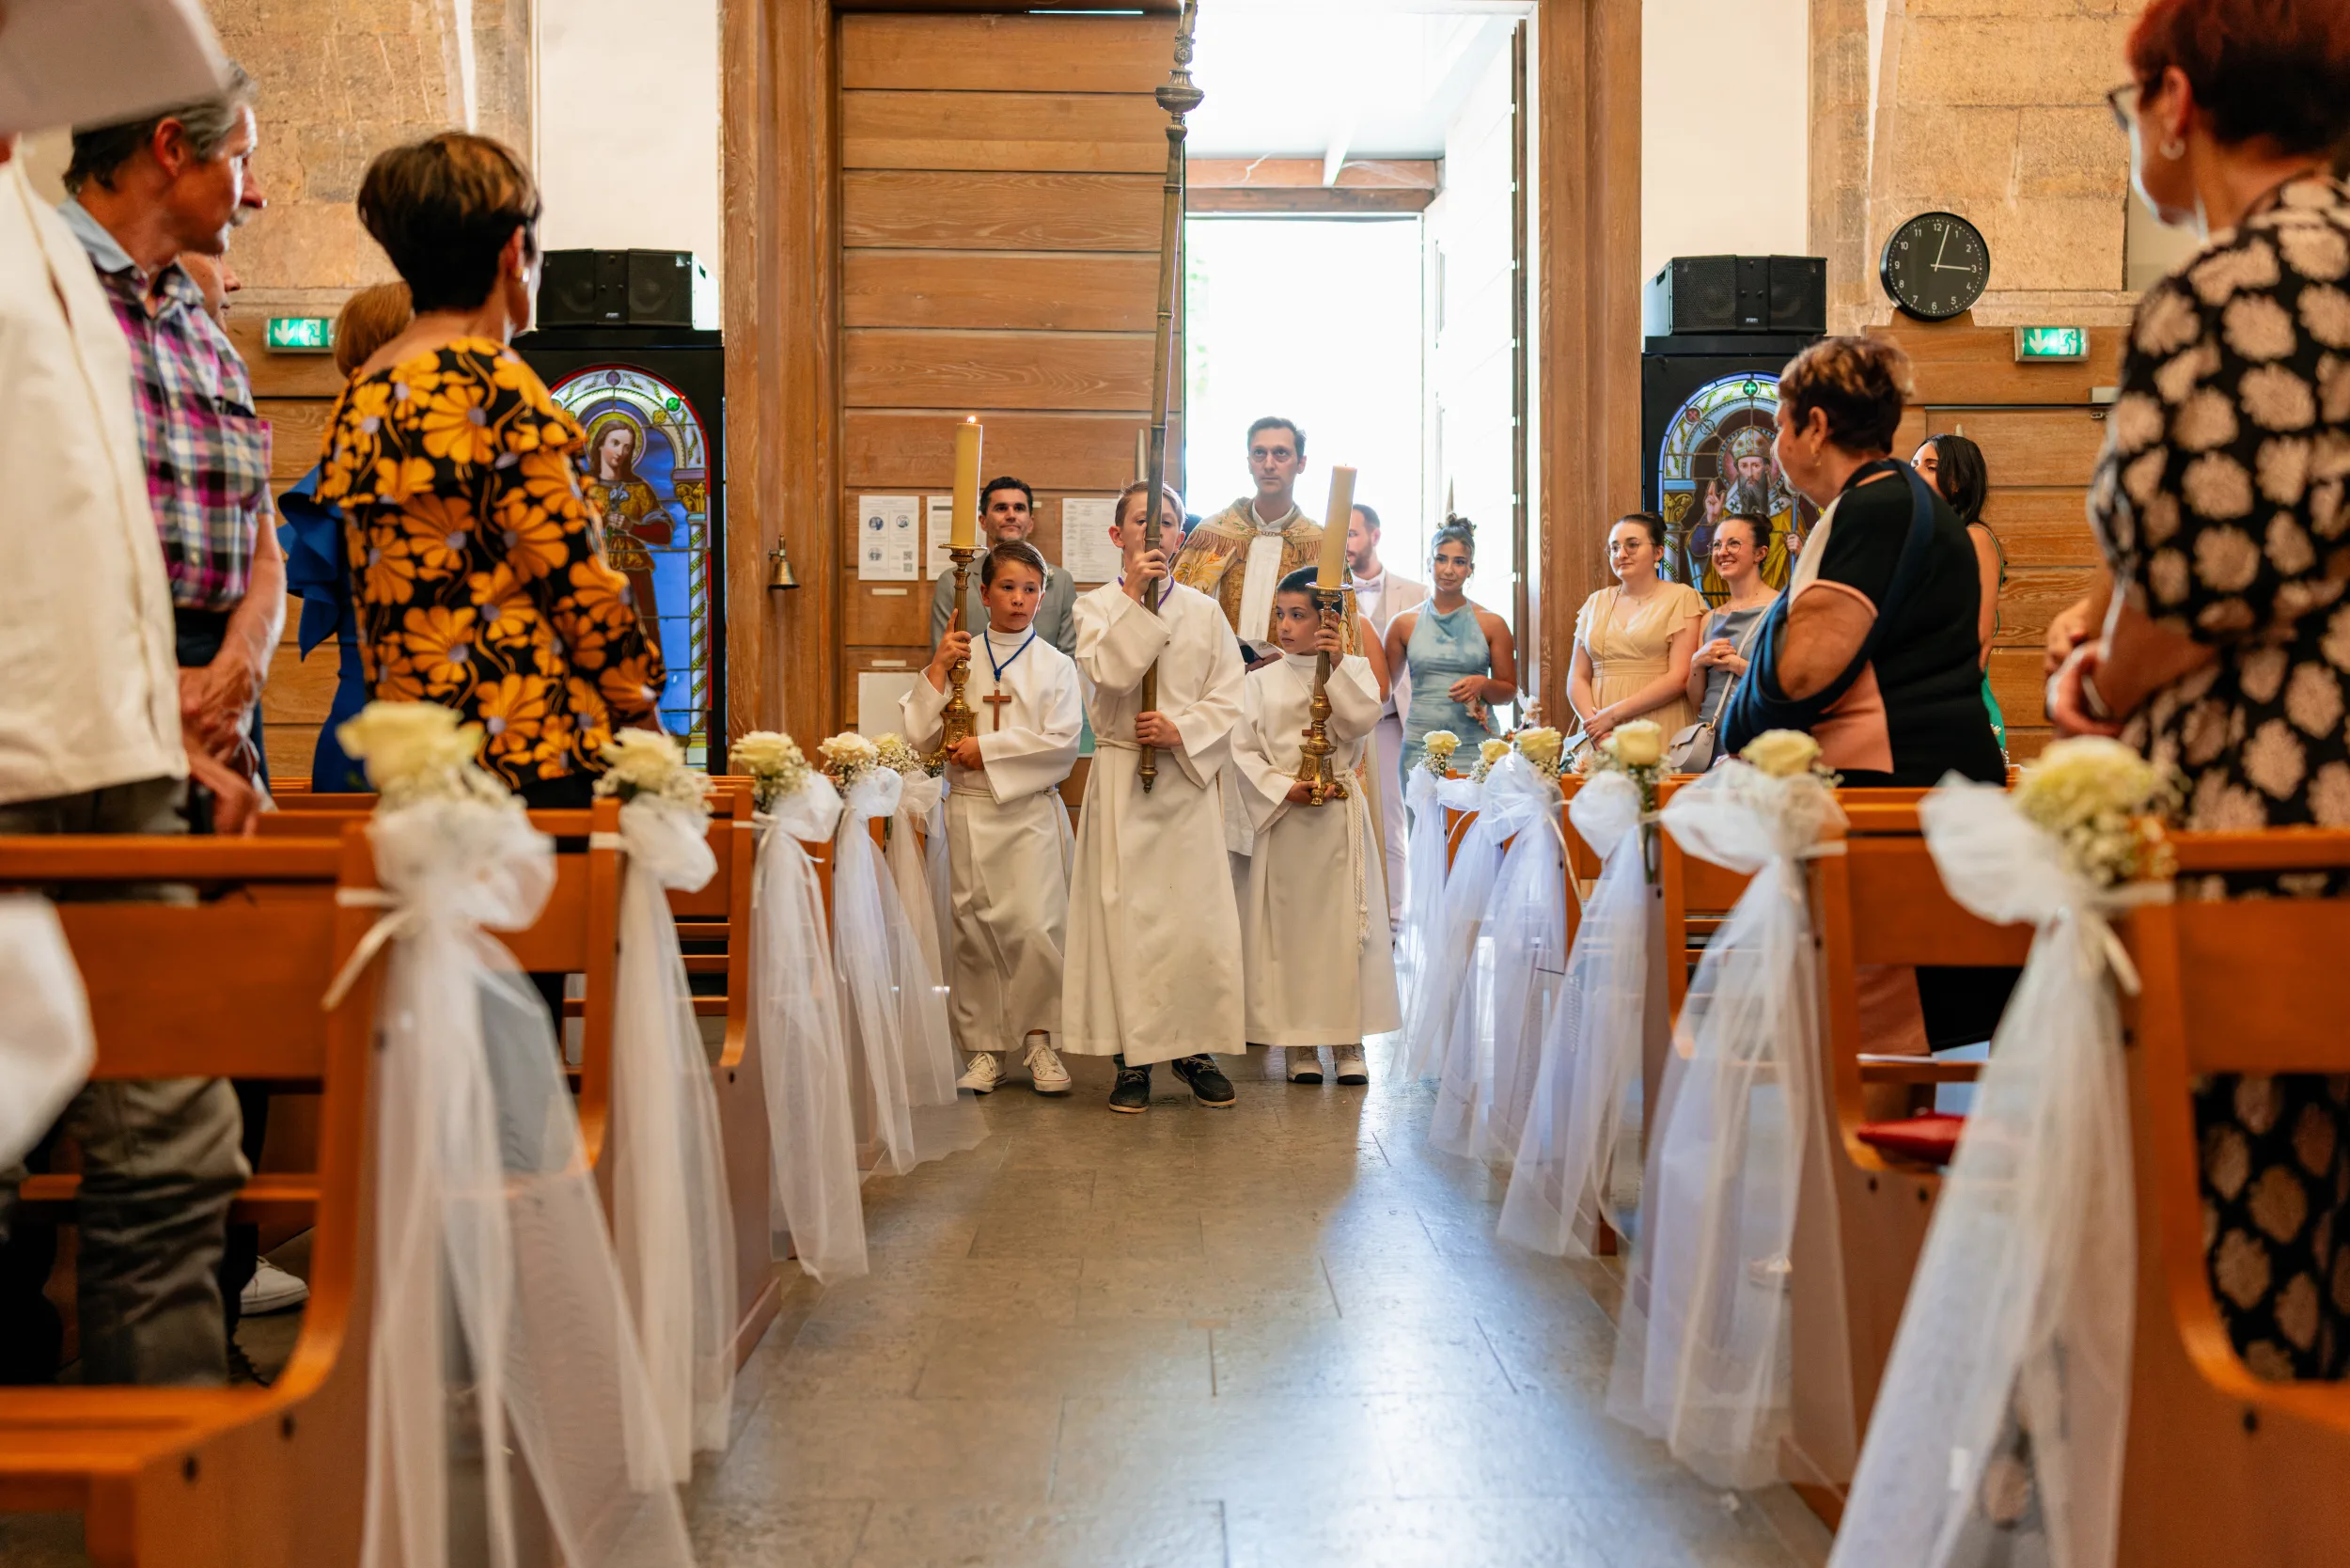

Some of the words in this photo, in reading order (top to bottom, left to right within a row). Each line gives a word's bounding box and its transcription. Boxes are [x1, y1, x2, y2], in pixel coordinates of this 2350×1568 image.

[1933, 223, 1942, 231] 12
[1914, 228, 1922, 237] 11
[1954, 230, 1959, 239] 1
[1900, 241, 1909, 250] 10
[1966, 244, 1972, 253] 2
[1894, 260, 1901, 270] 9
[1971, 264, 1977, 274] 3
[1899, 279, 1904, 289] 8
[1966, 282, 1971, 290] 4
[1912, 294, 1919, 303] 7
[1950, 296, 1957, 306] 5
[1931, 302, 1937, 311] 6
